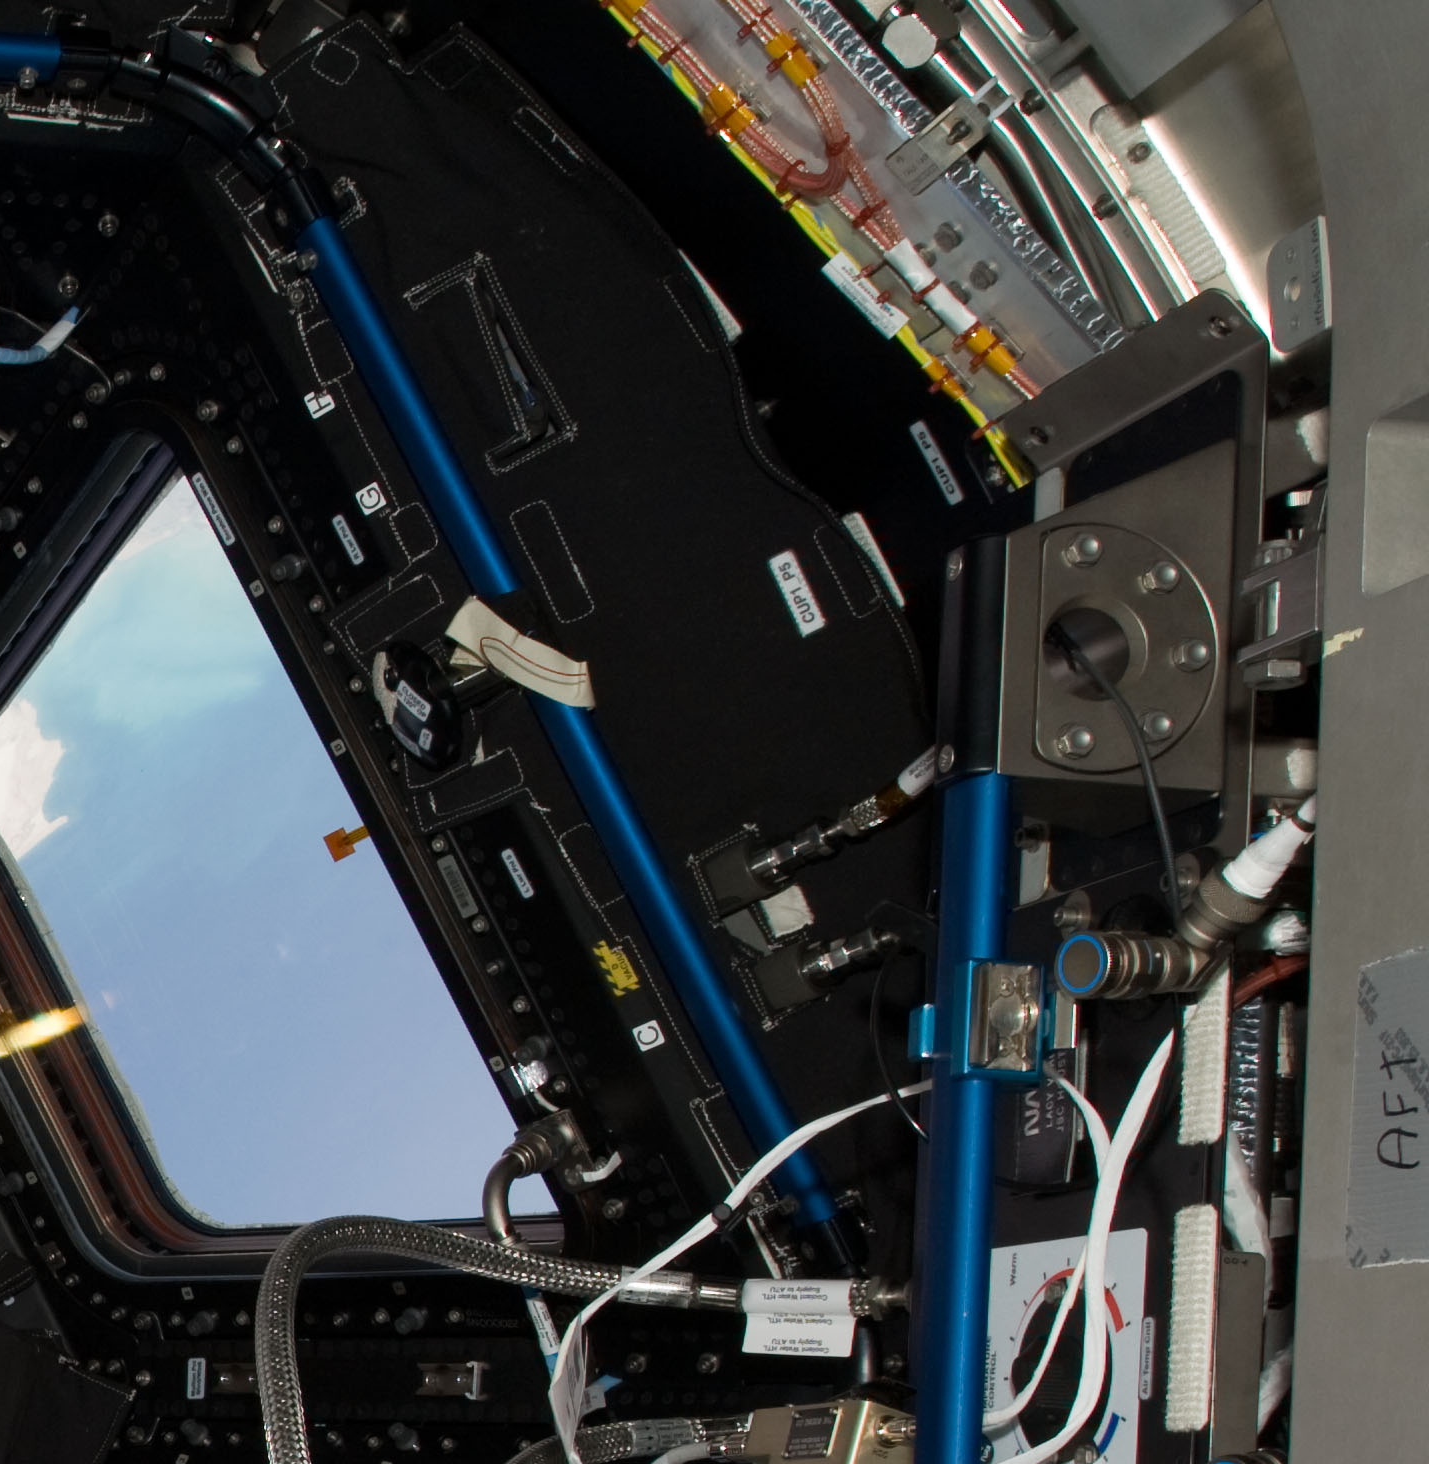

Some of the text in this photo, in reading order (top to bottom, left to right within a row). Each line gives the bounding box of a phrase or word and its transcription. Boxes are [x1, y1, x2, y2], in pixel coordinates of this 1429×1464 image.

[307, 394, 332, 416] H
[359, 487, 381, 510] G
[778, 562, 815, 624] CUP1_P5
[401, 685, 427, 711] CLOSED
[613, 951, 633, 981] VACUU
[637, 1026, 659, 1045] C
[1009, 1252, 1018, 1287] Warm
[1142, 1347, 1150, 1378] Temp
[988, 1351, 997, 1408] CONTROL
[1141, 1380, 1149, 1395] Air
